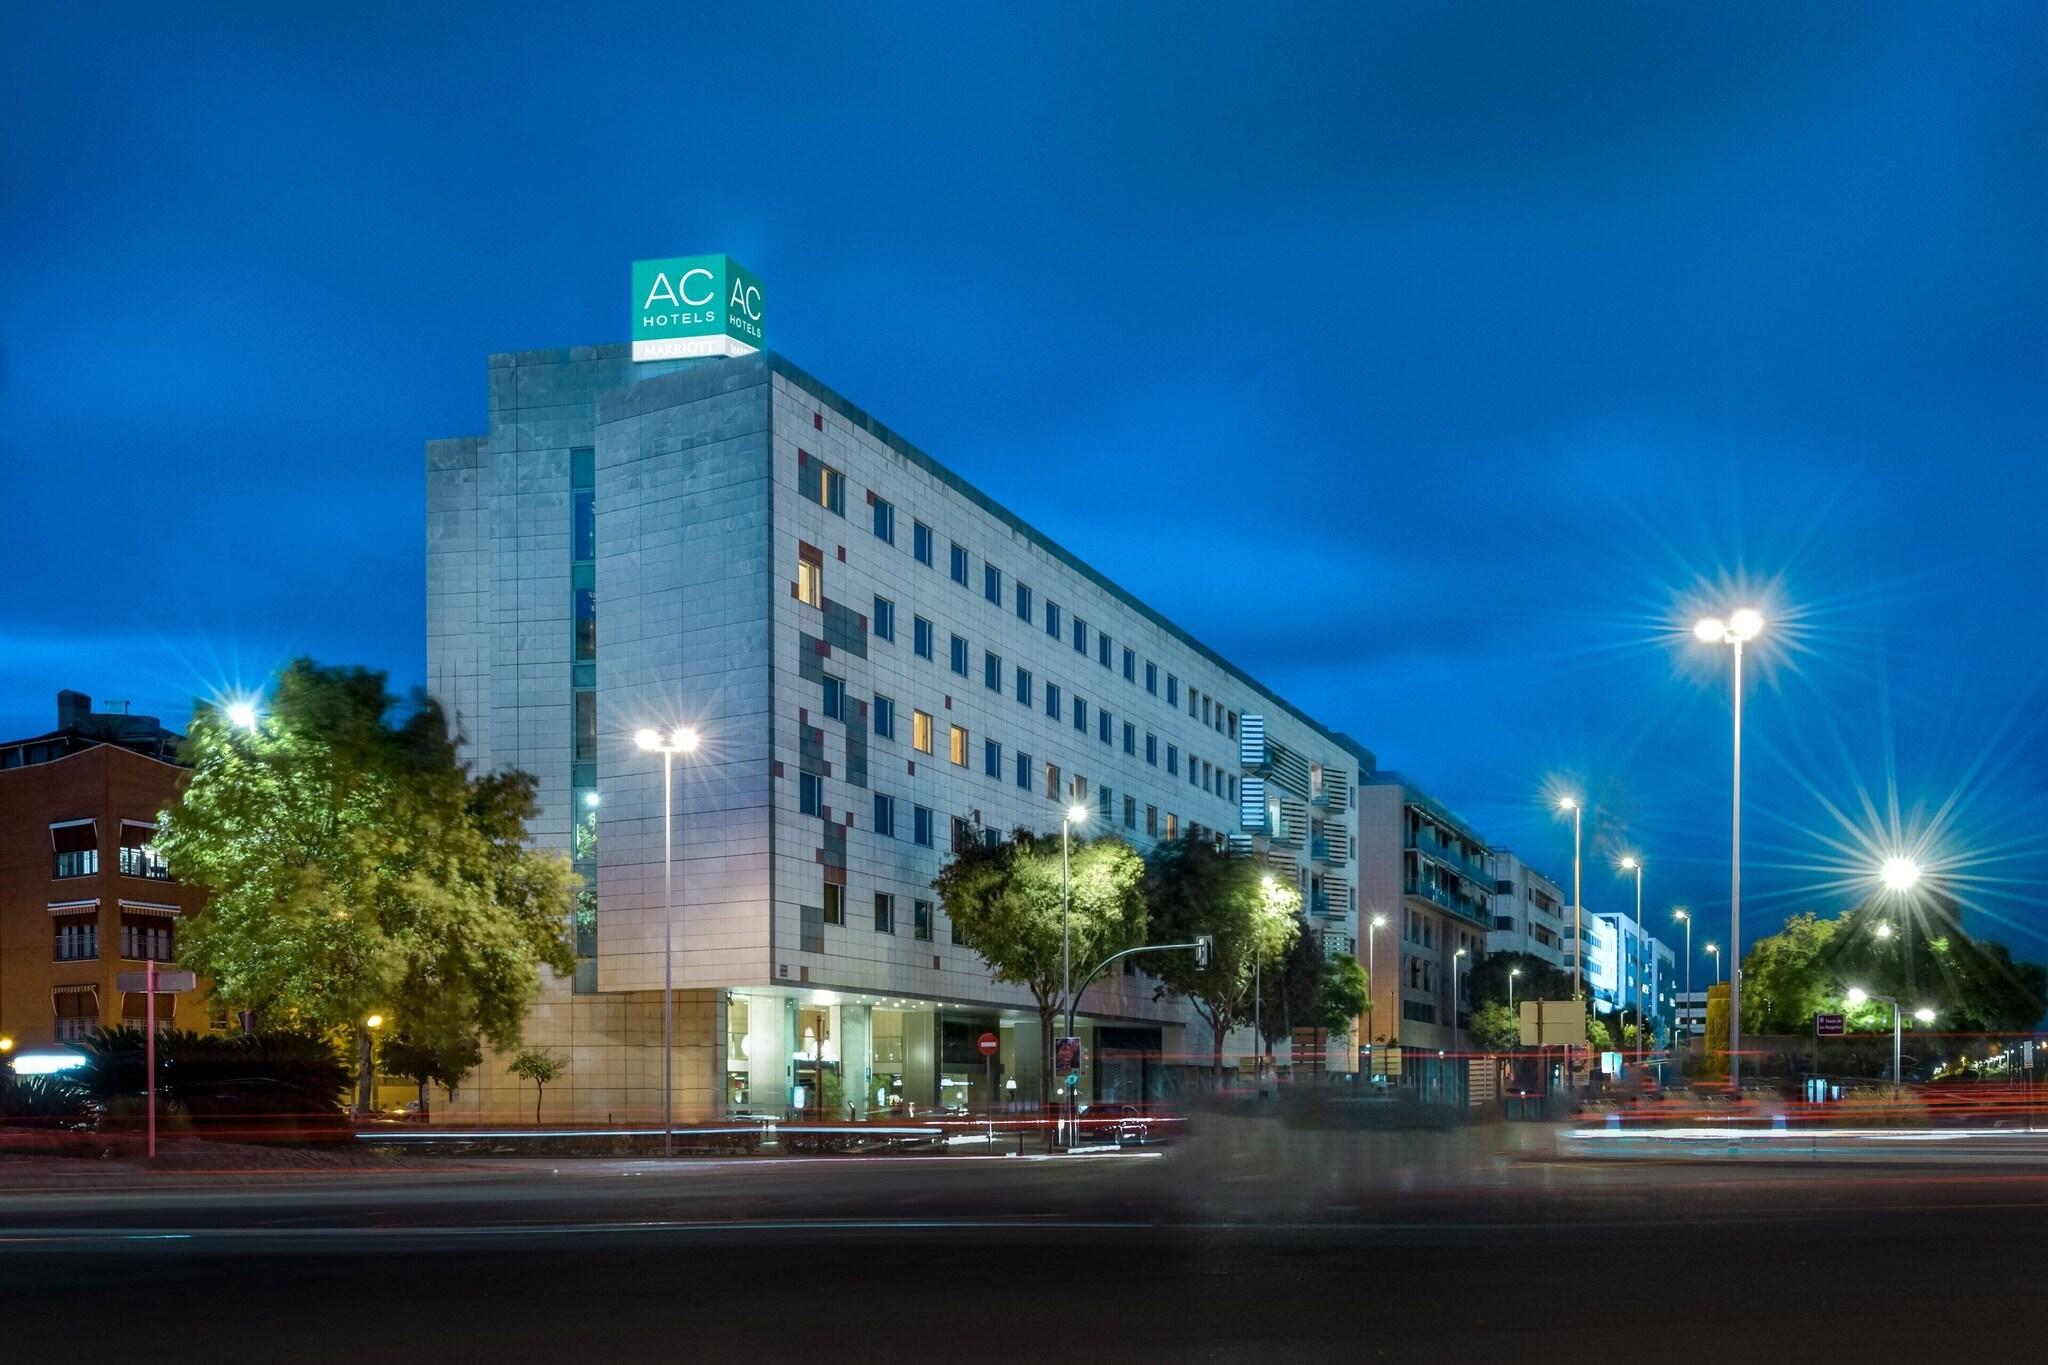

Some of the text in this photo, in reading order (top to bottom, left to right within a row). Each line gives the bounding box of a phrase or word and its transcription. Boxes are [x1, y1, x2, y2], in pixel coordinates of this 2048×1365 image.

[644, 268, 714, 309] AC
[730, 277, 761, 320] AC
[643, 311, 715, 328] HOTELS
[729, 314, 761, 338] HOTELS
